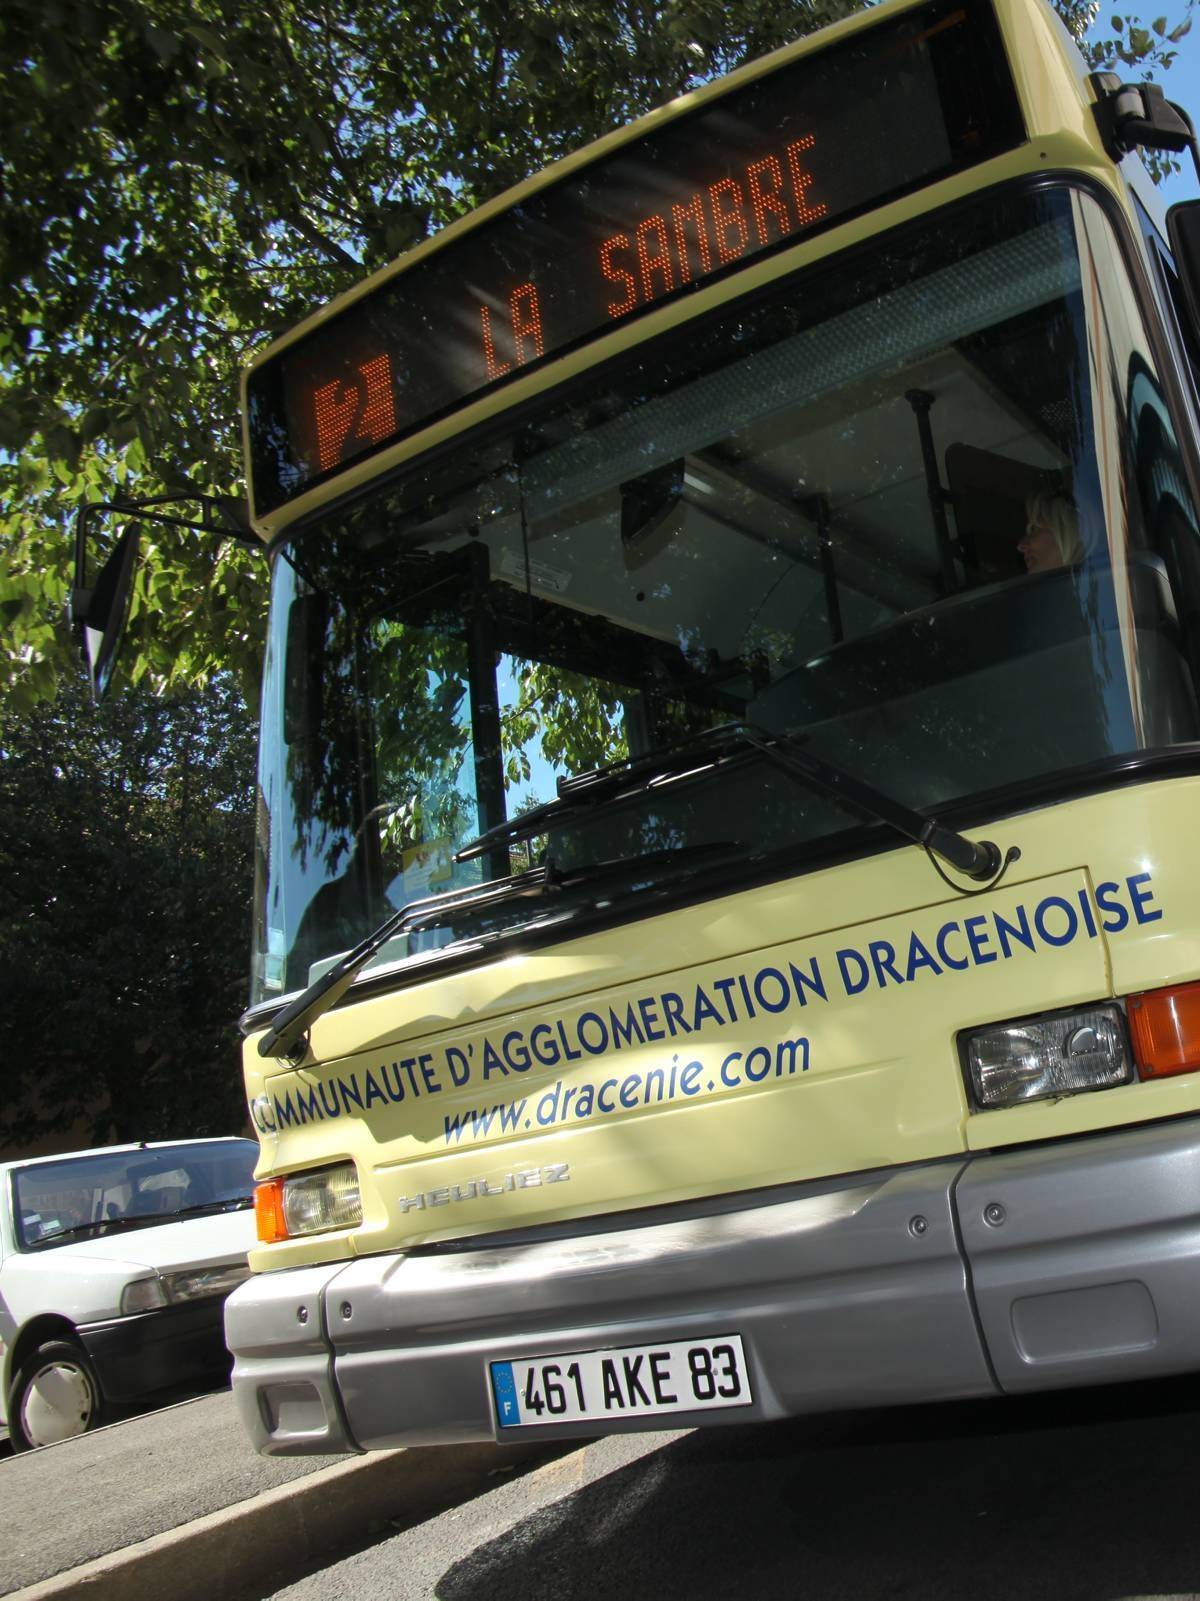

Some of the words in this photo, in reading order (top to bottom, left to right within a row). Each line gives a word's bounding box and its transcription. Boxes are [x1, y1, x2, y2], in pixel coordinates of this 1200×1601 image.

[480, 282, 545, 381] LA
[599, 134, 828, 318] SAMBRE
[251, 1053, 442, 1134] COMMUNAUTE
[446, 956, 829, 1087] D'AGGLOMERATION
[836, 872, 1163, 996] DRACENOISE
[444, 1036, 811, 1145] www.dracenie.com
[398, 1163, 571, 1214] HEULIEZ
[503, 1401, 512, 1416] F
[524, 1362, 586, 1416] 461
[601, 1351, 679, 1410] AKE
[687, 1344, 742, 1401] 83
